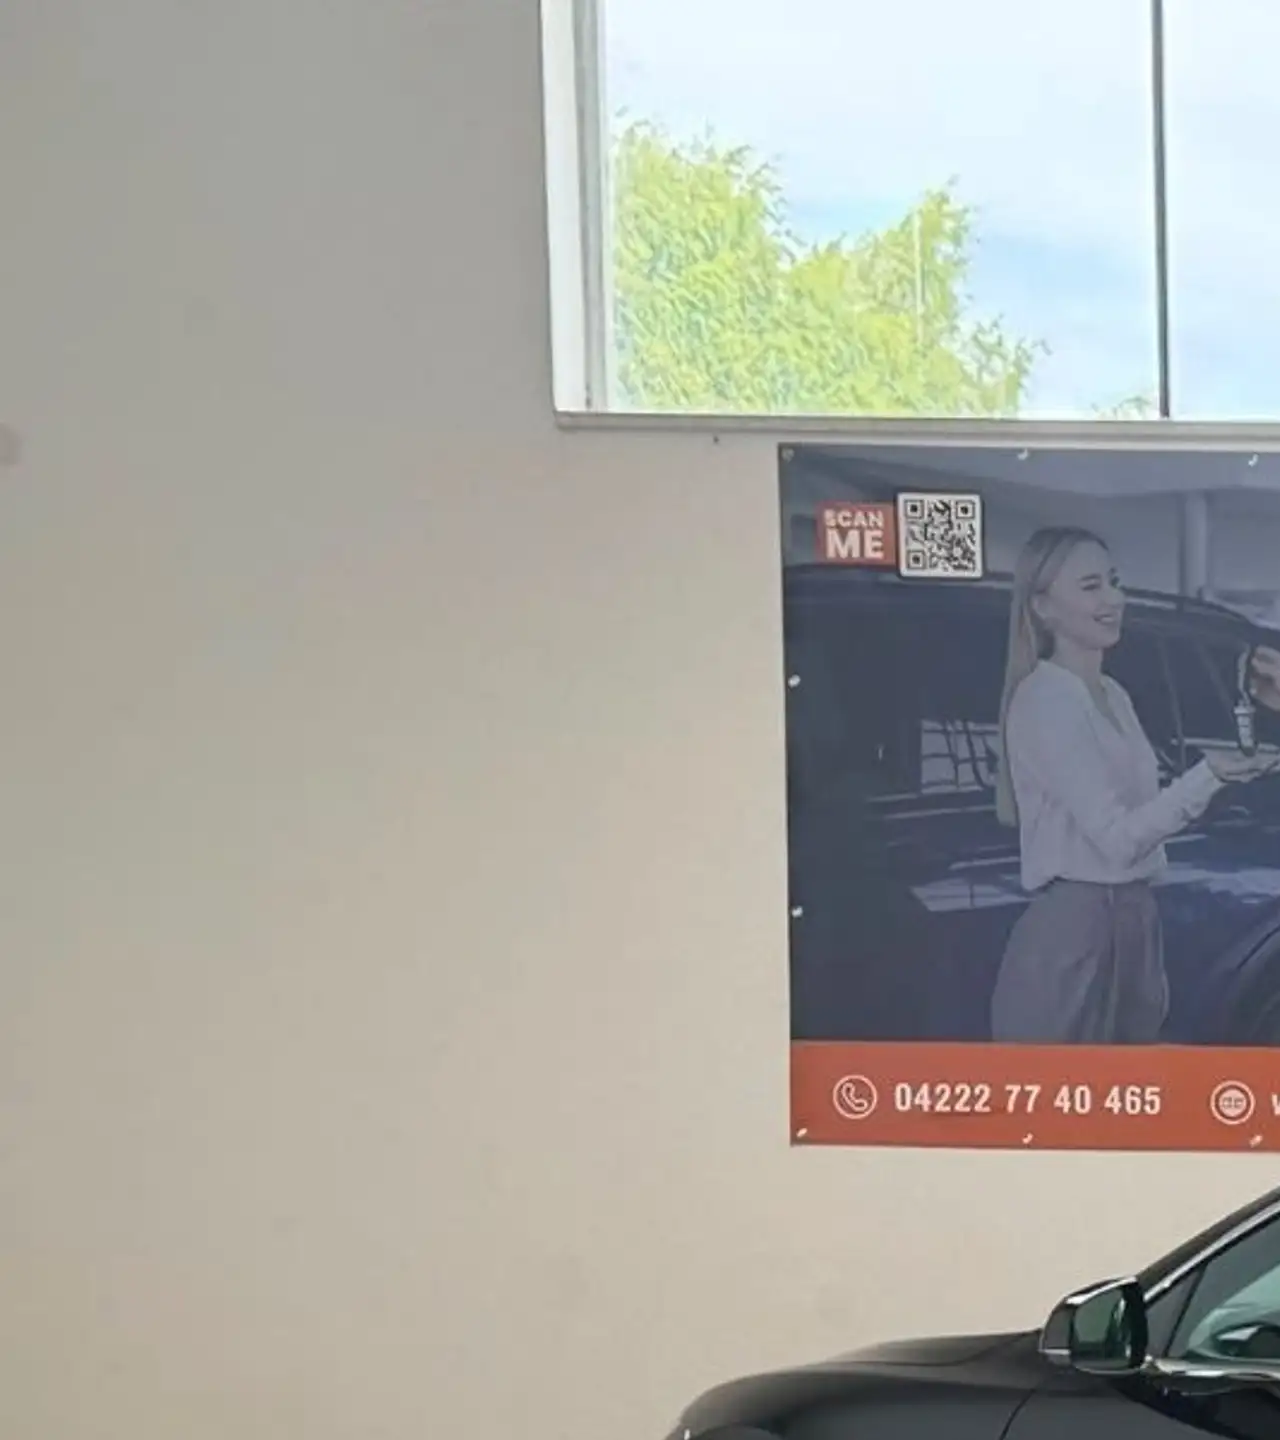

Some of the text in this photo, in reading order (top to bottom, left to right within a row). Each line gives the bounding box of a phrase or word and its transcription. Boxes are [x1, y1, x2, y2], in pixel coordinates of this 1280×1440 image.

[823, 509, 884, 529] SCAN
[826, 529, 885, 560] ME
[893, 1082, 1162, 1116] 04222 77 40 465
